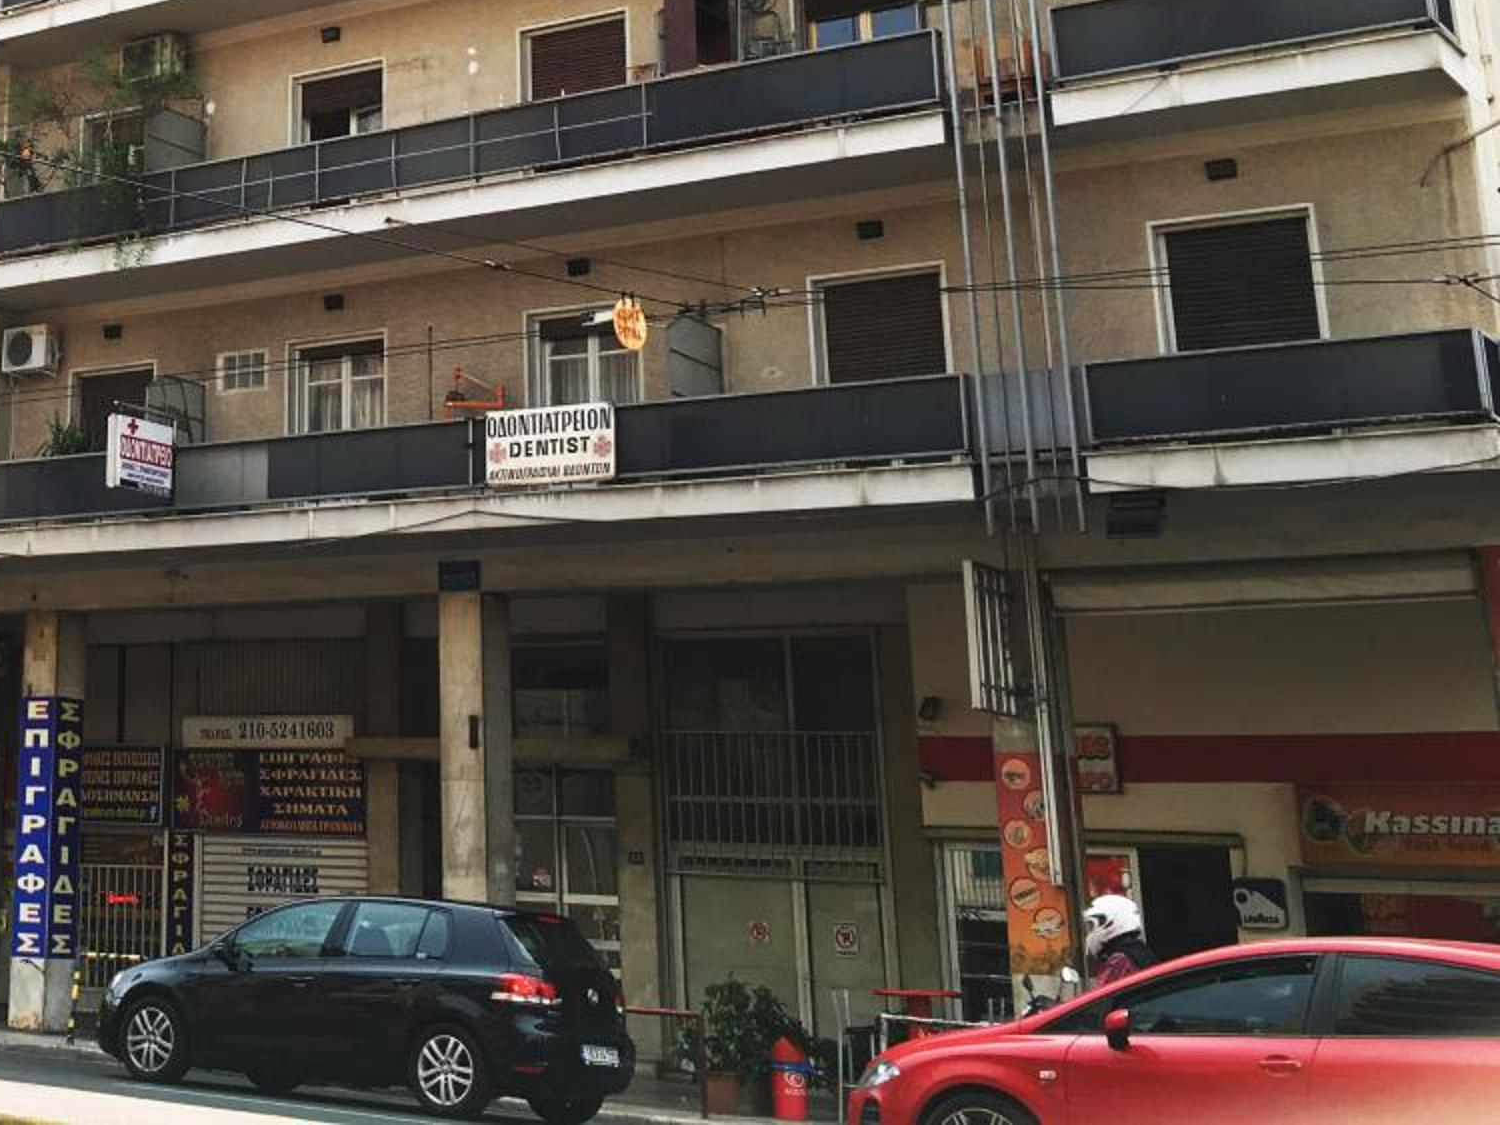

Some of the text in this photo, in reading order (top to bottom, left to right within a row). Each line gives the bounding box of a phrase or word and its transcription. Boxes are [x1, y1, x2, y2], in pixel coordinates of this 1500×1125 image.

[487, 407, 612, 438] ΟΔΟΝΤΙΑΤΡΕΙΟΝ
[509, 436, 590, 458] DENTIST
[16, 700, 49, 954] ΕΠΙΓΡΑΦΕΣ
[51, 701, 81, 955] ΣΦΡΑΓΙΔΕΣ
[273, 803, 349, 816] ΣΗΜΑΤΑ
[171, 834, 190, 955] ΣΦΡΑΓΙΔ
